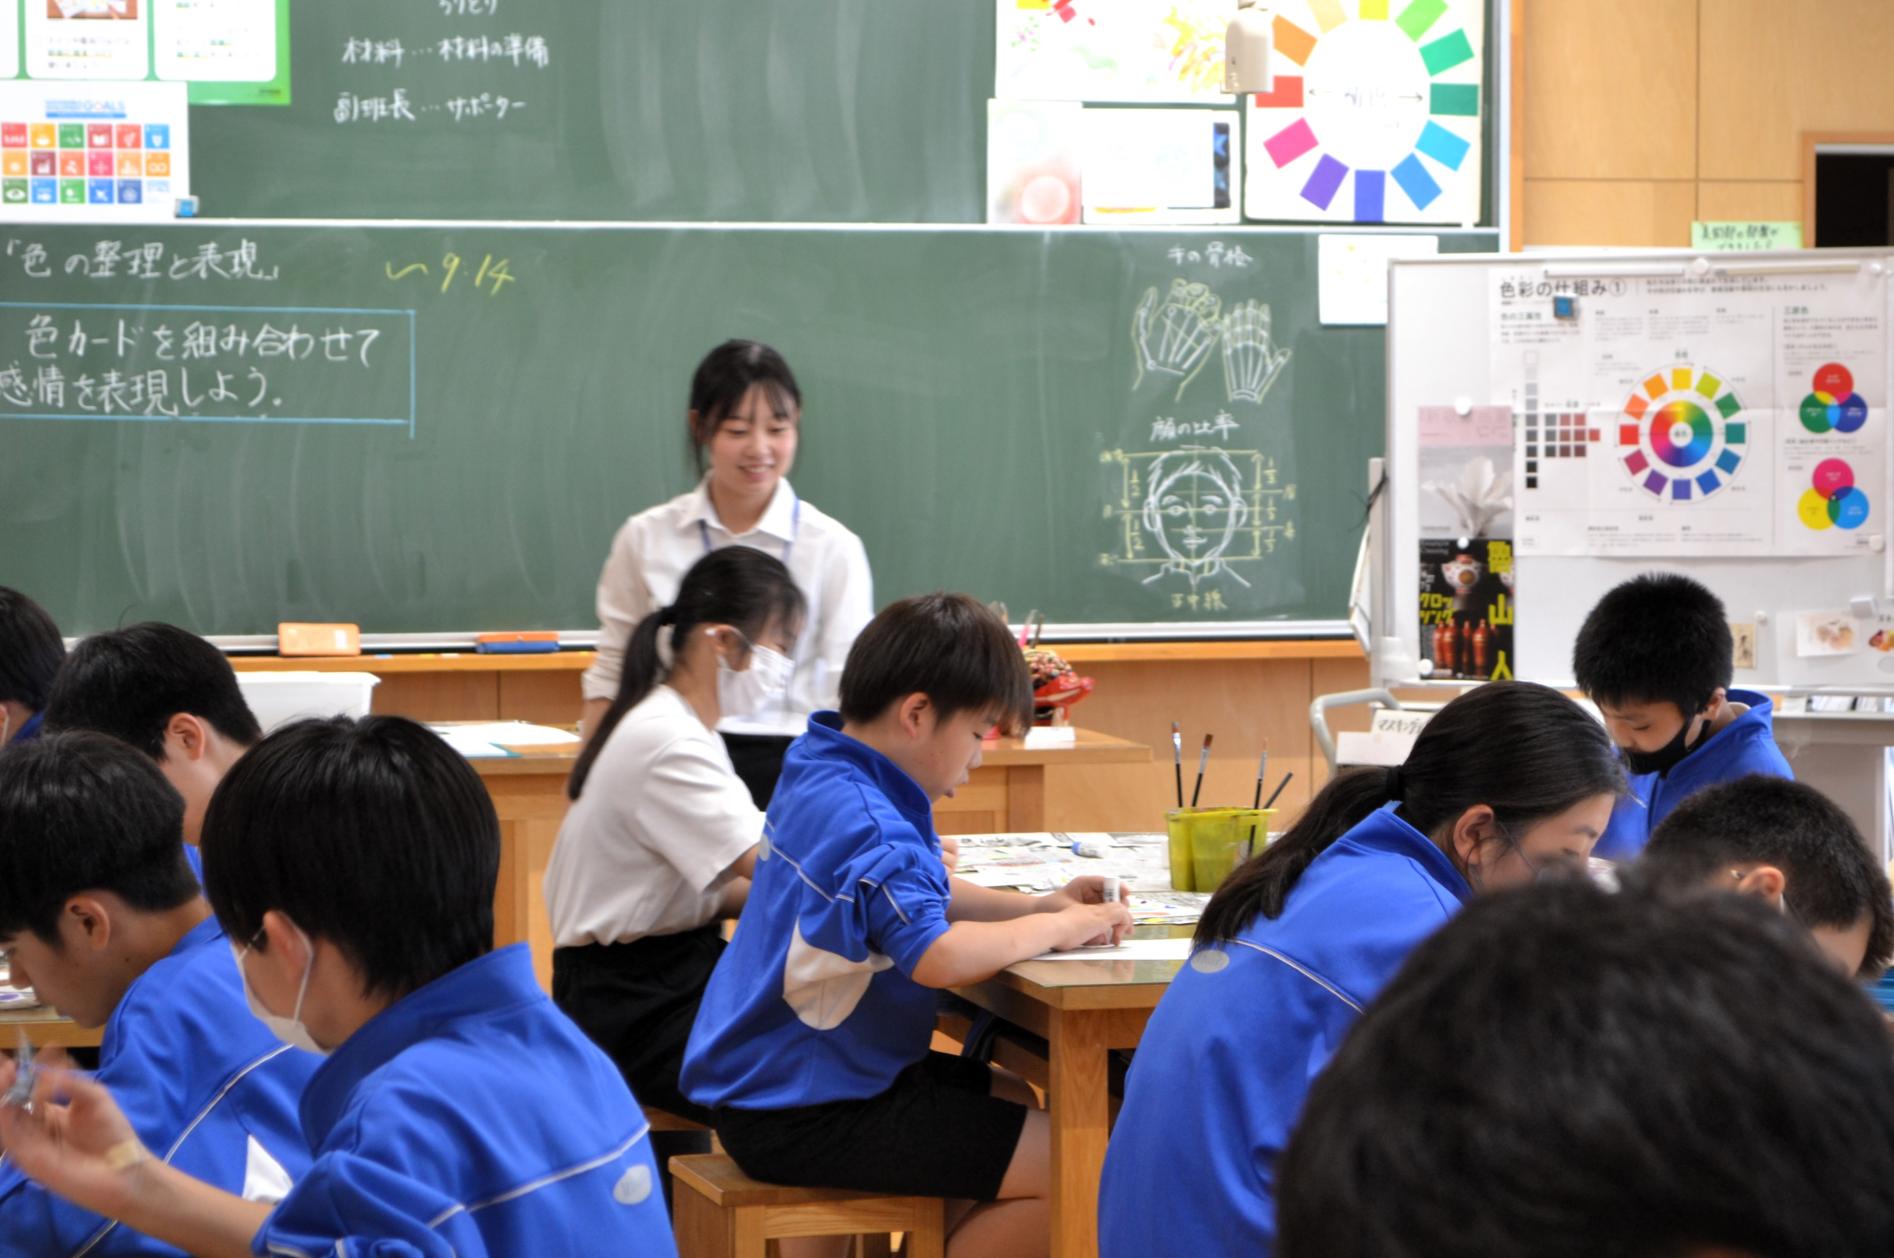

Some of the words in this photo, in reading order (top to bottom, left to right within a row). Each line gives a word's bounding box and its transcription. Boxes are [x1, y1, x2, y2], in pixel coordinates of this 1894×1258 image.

[25, 314, 381, 368] 色カードを組み合わせて
